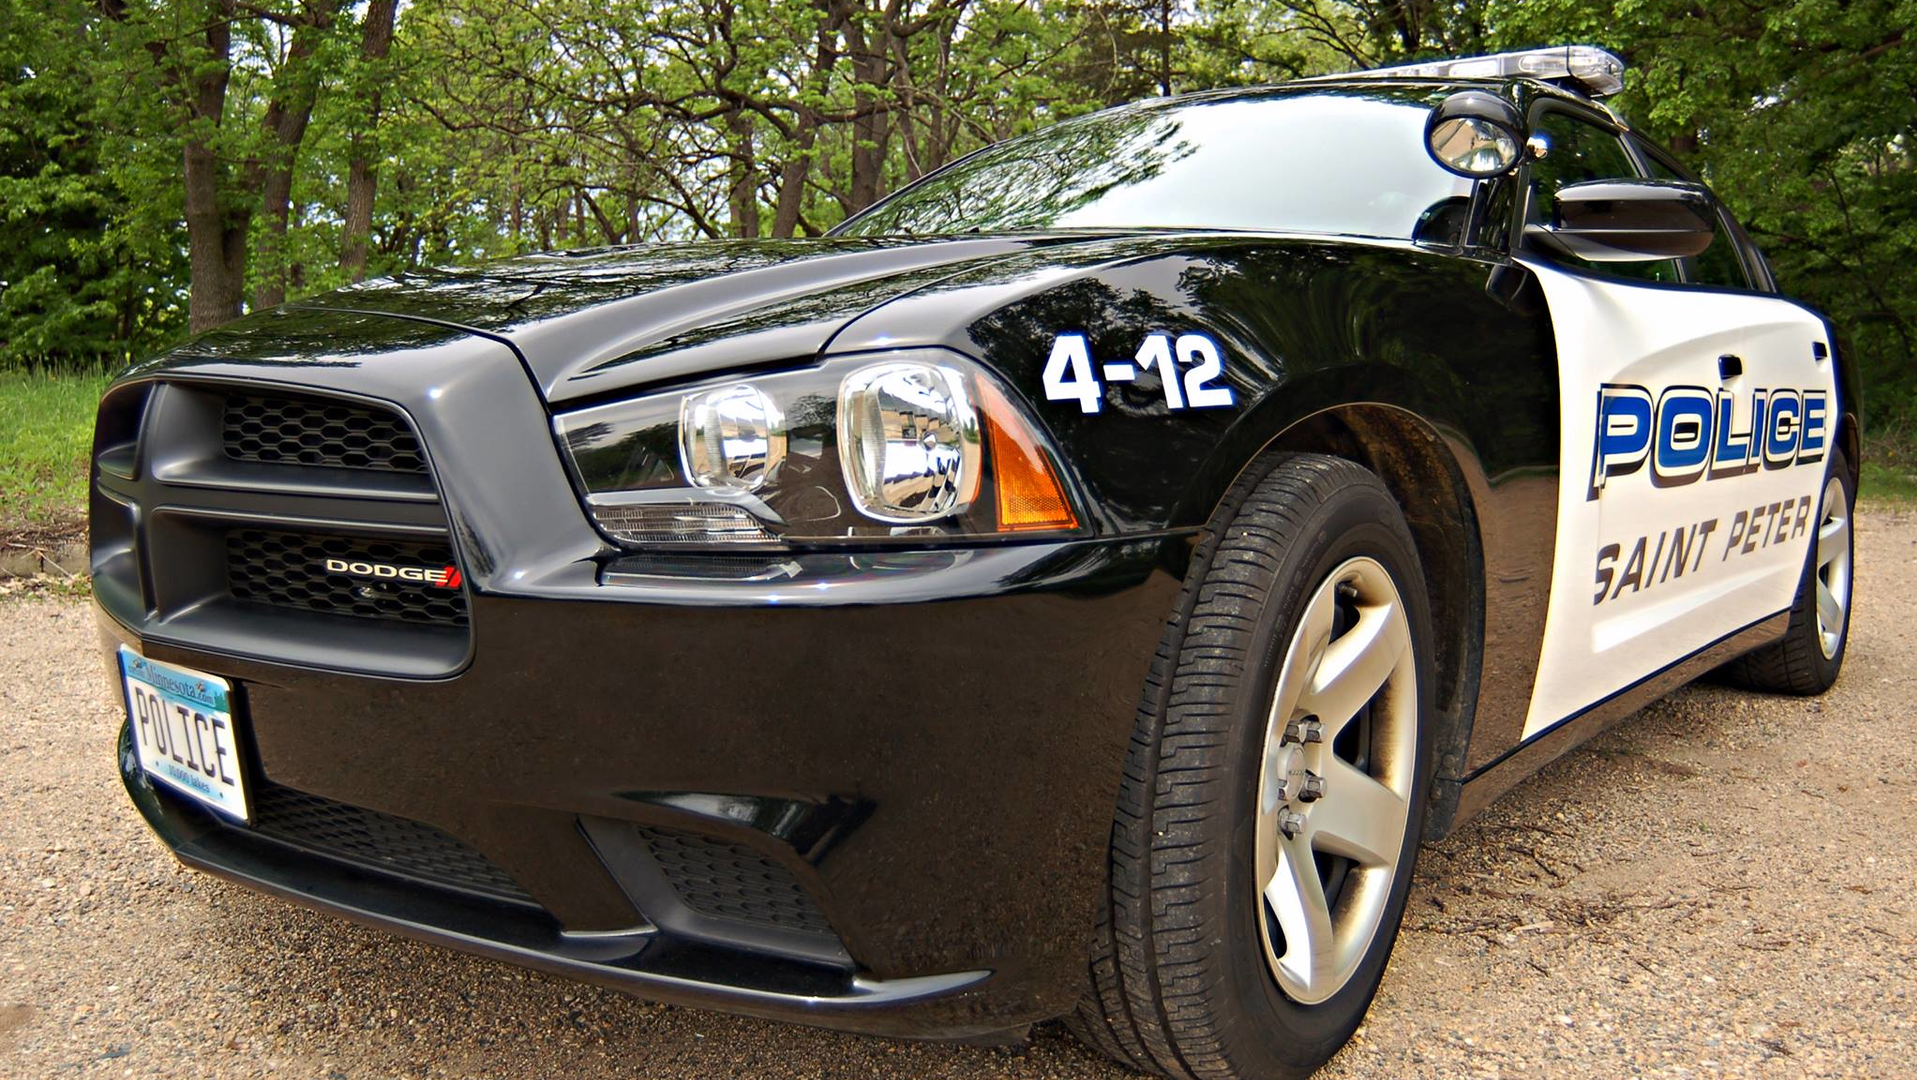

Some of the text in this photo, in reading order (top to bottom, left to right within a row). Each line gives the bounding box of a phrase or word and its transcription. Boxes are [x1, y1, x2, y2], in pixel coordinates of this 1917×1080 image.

[1042, 334, 1233, 414] 4-12
[1587, 383, 1827, 502] POLICE
[326, 559, 448, 583] DODGE
[1594, 495, 1811, 606] SAINT PETER
[135, 686, 235, 787] POLICE
